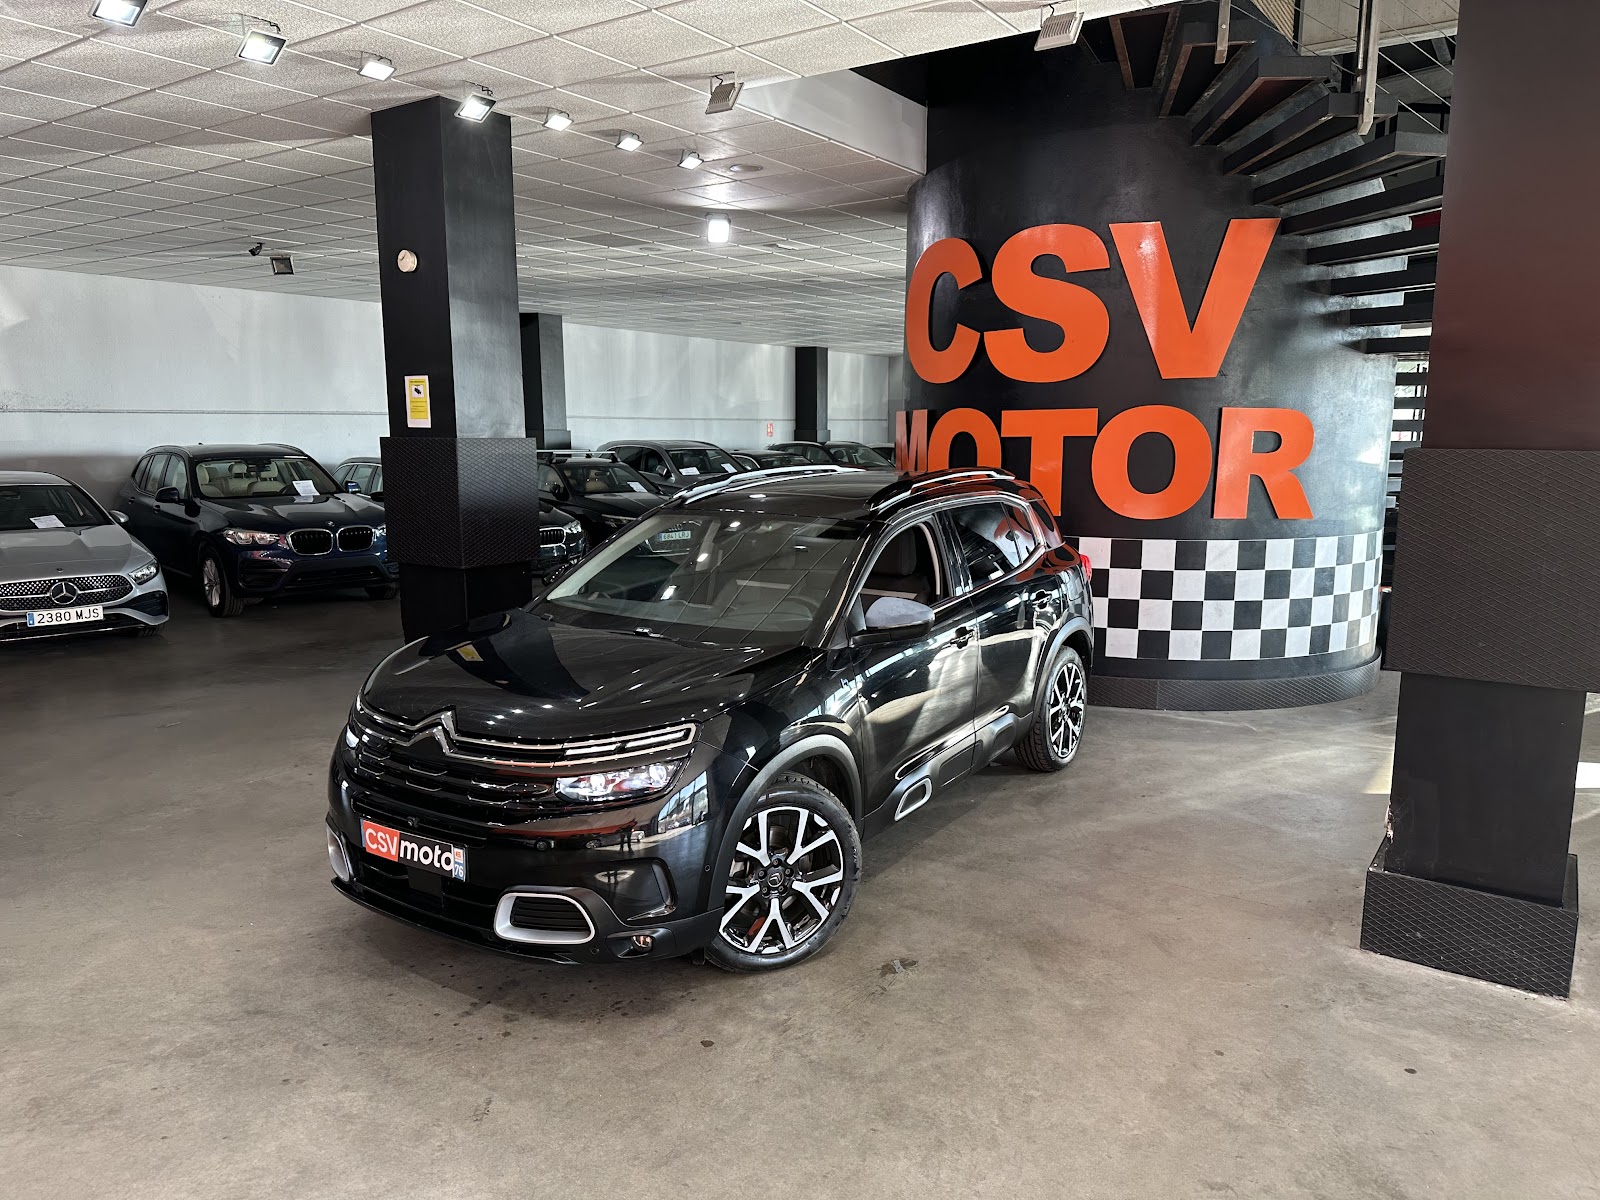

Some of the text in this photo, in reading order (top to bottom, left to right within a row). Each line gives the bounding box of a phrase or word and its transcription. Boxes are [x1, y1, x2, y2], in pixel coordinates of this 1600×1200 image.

[905, 217, 1282, 384] CSV
[895, 404, 1315, 520] MOTOR
[37, 607, 99, 624] 2380 MJS
[454, 864, 464, 878] 76
